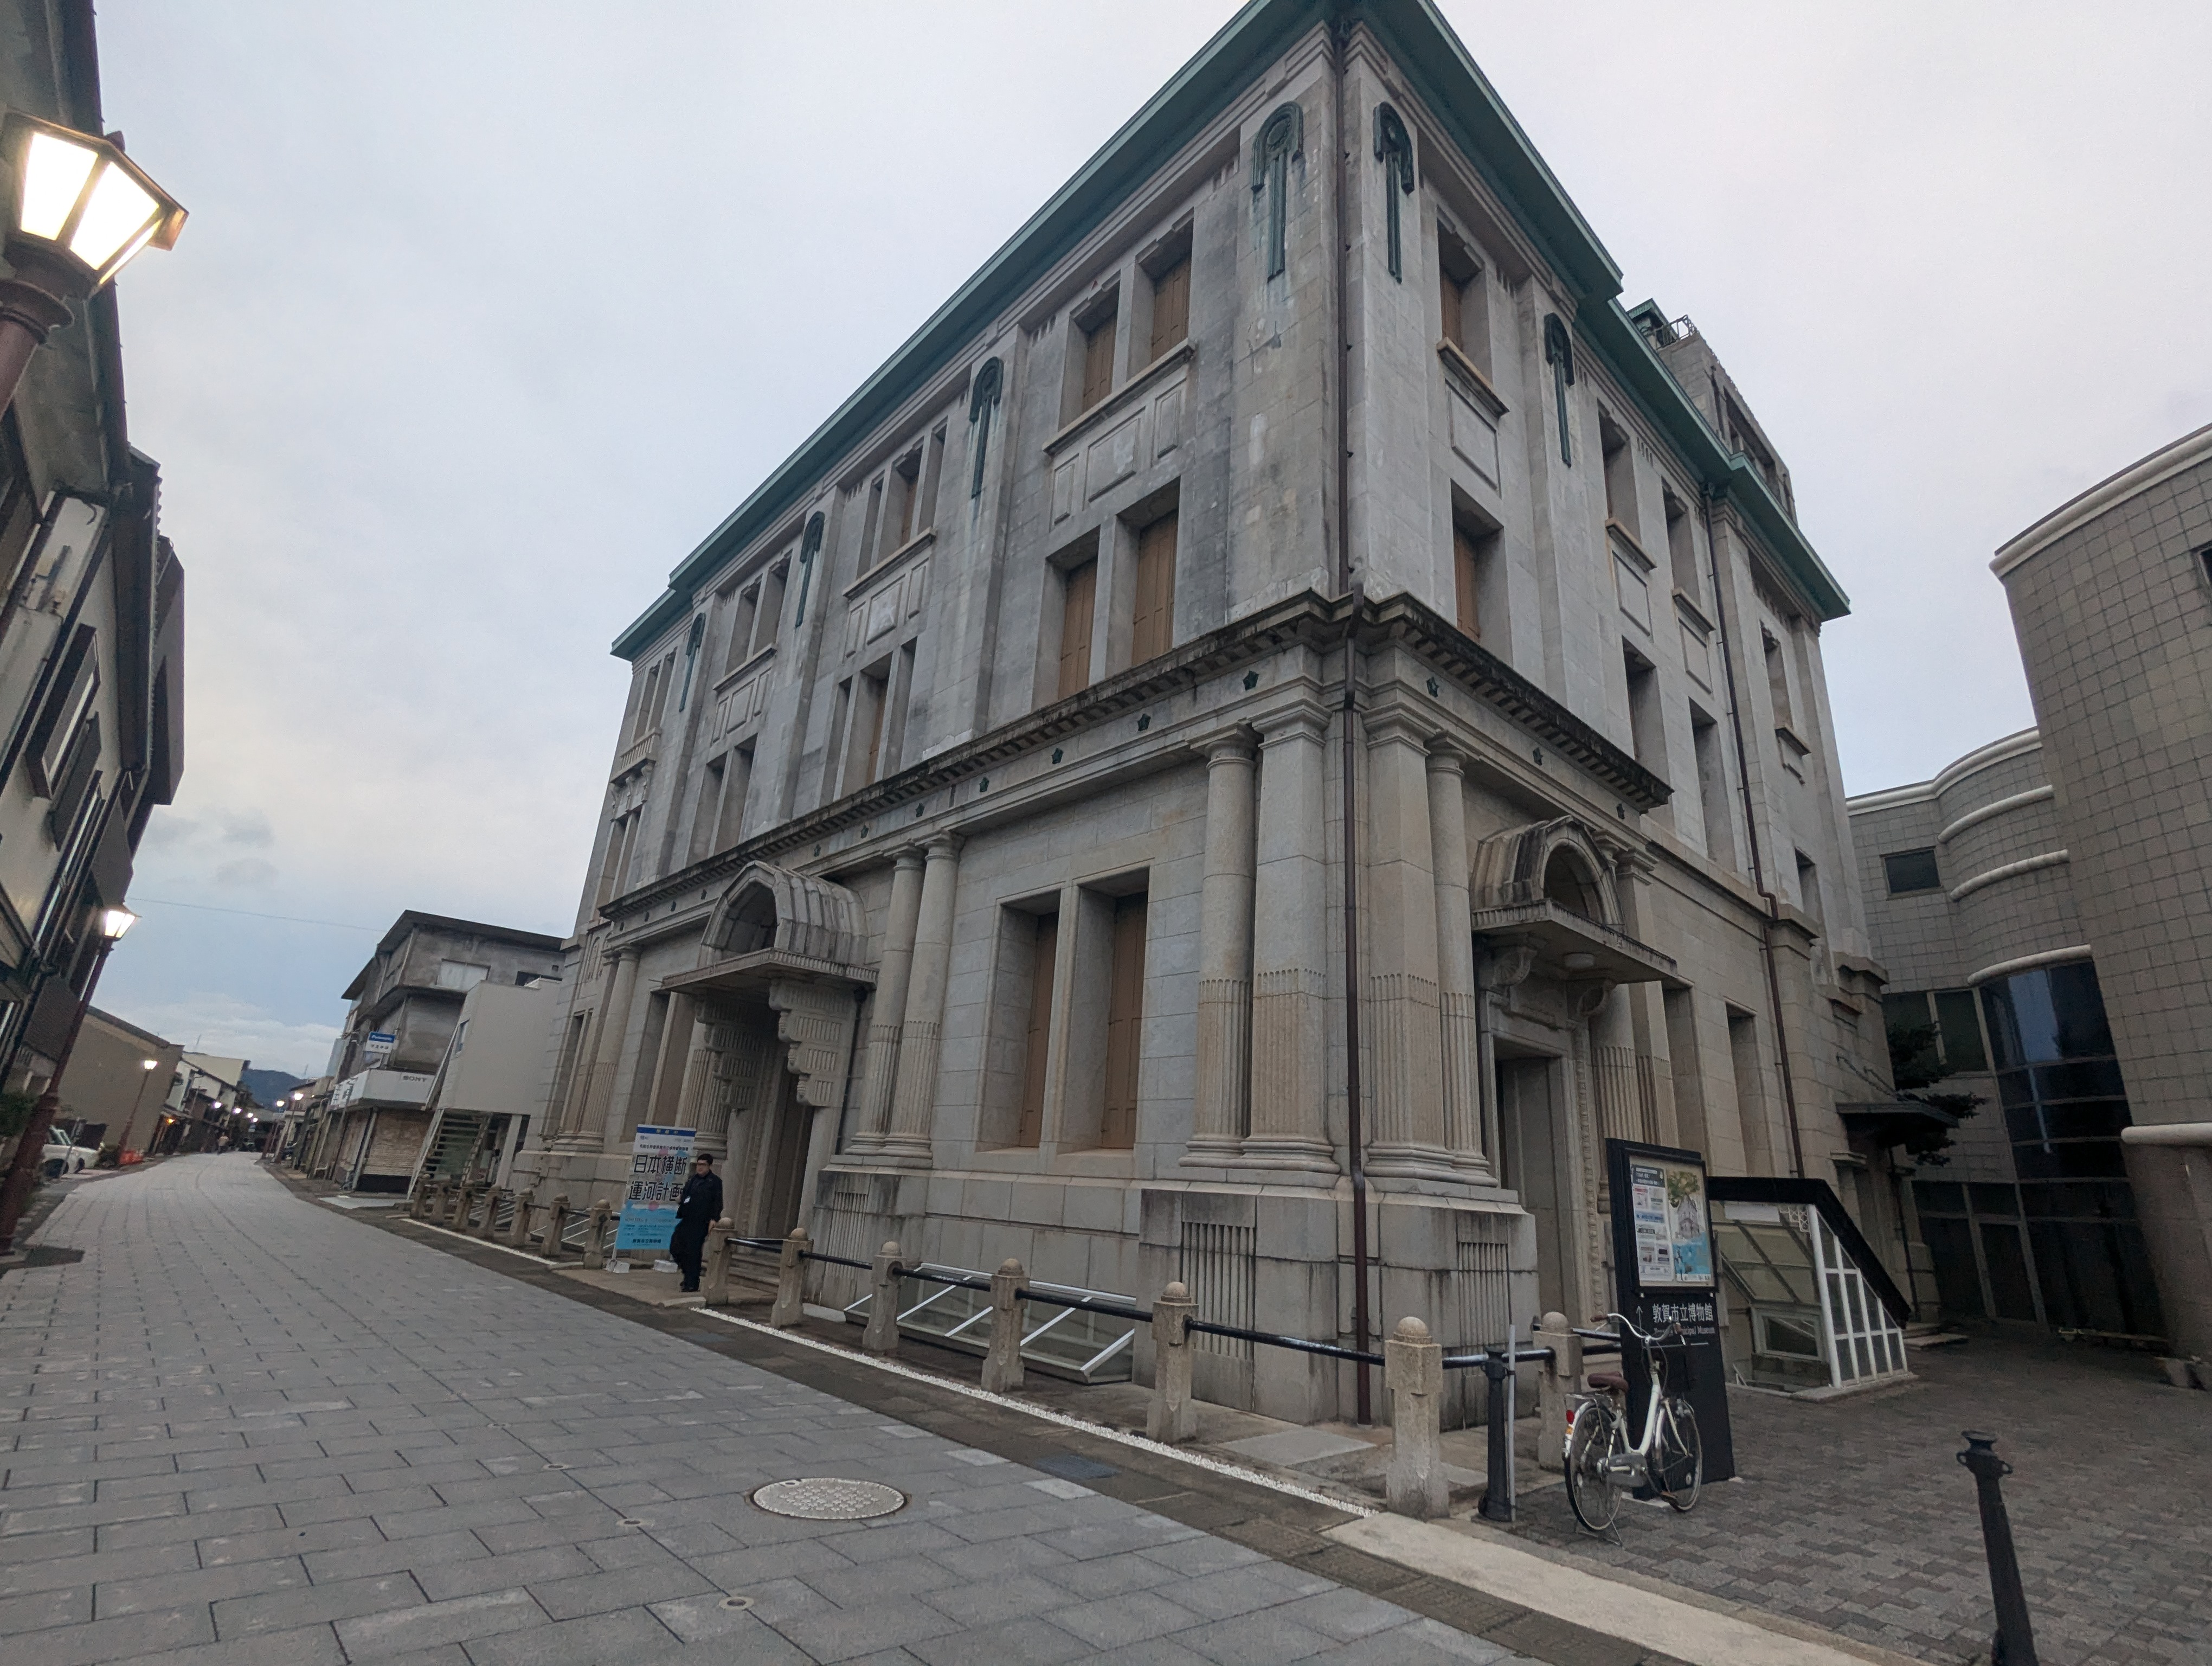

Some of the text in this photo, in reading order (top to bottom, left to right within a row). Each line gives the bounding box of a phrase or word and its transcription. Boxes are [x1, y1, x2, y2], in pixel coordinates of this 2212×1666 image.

[634, 1155, 687, 1176] 日本横断
[628, 1181, 684, 1201] 運河計画
[1652, 1303, 1714, 1323] 敦賀市立博物館
